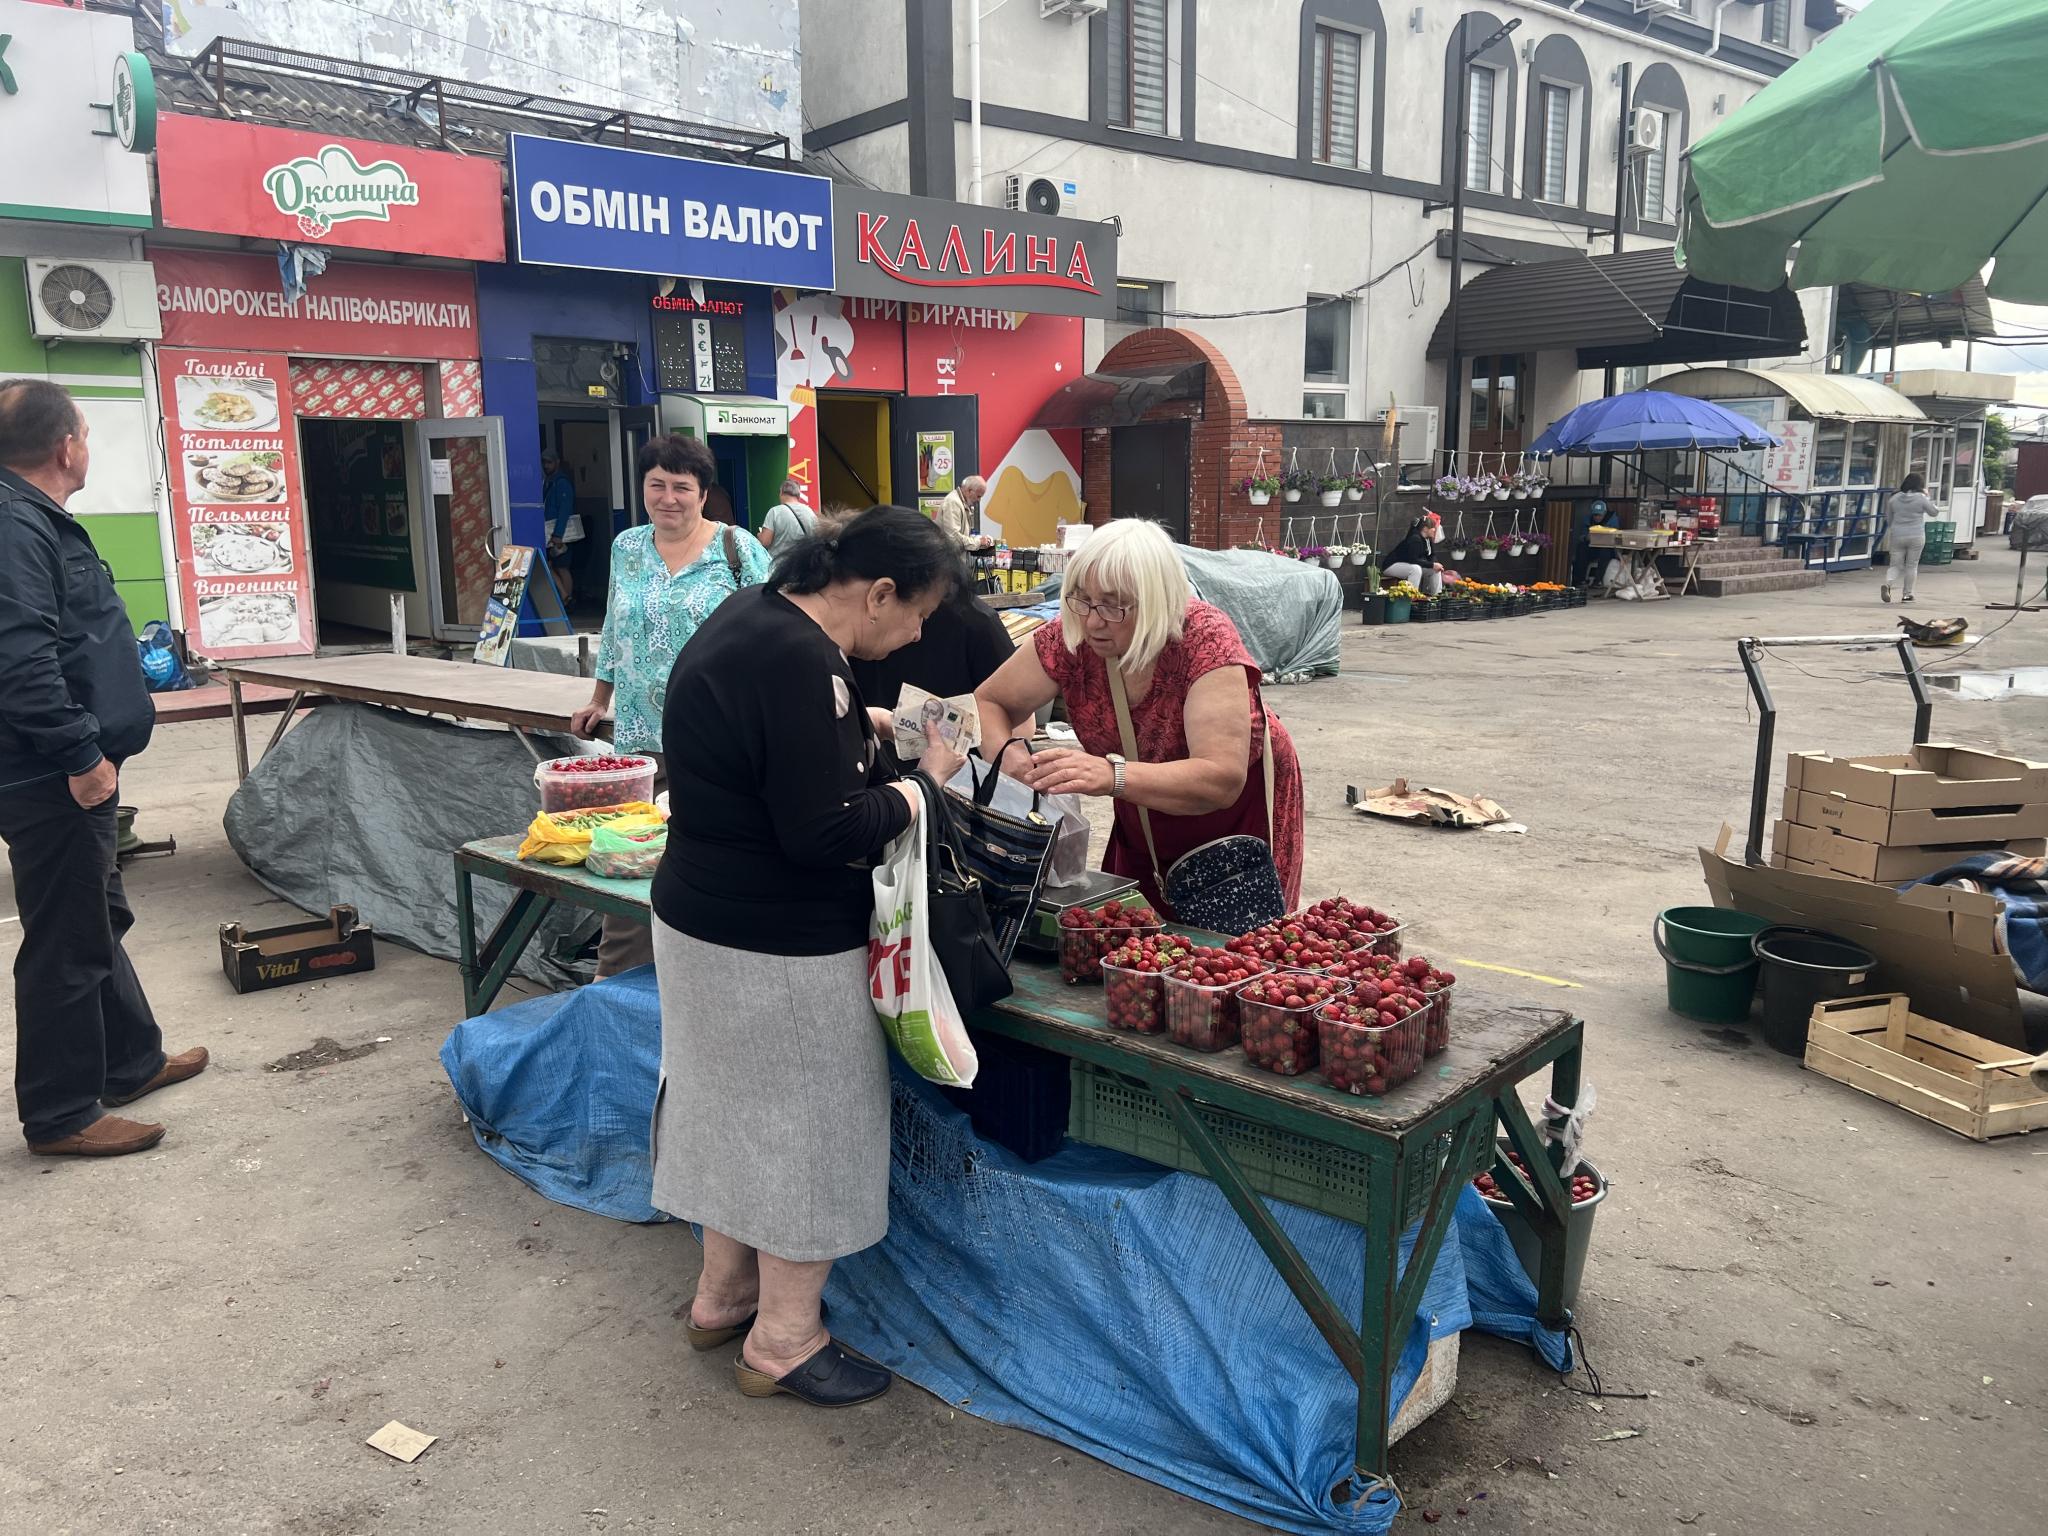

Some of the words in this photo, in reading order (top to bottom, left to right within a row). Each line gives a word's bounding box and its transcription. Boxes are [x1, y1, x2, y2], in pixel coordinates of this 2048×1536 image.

[266, 167, 416, 212] Оксанина
[530, 180, 670, 235] ОБМІН
[683, 199, 823, 251] ВАЛЮТ
[857, 211, 1094, 286] КАЛИНА
[158, 284, 299, 319] ЗАМОРОЖЕНІ
[304, 294, 471, 329] НАПІВФАБРИКАТИ
[652, 296, 695, 311] ОБМІН
[184, 358, 265, 381] Голубці
[731, 414, 776, 424] Банкомат
[179, 433, 284, 450] Котлети
[187, 507, 291, 523] Пельмені
[193, 579, 299, 598] Вареники
[898, 718, 918, 731] 500
[255, 958, 301, 981] Vital
